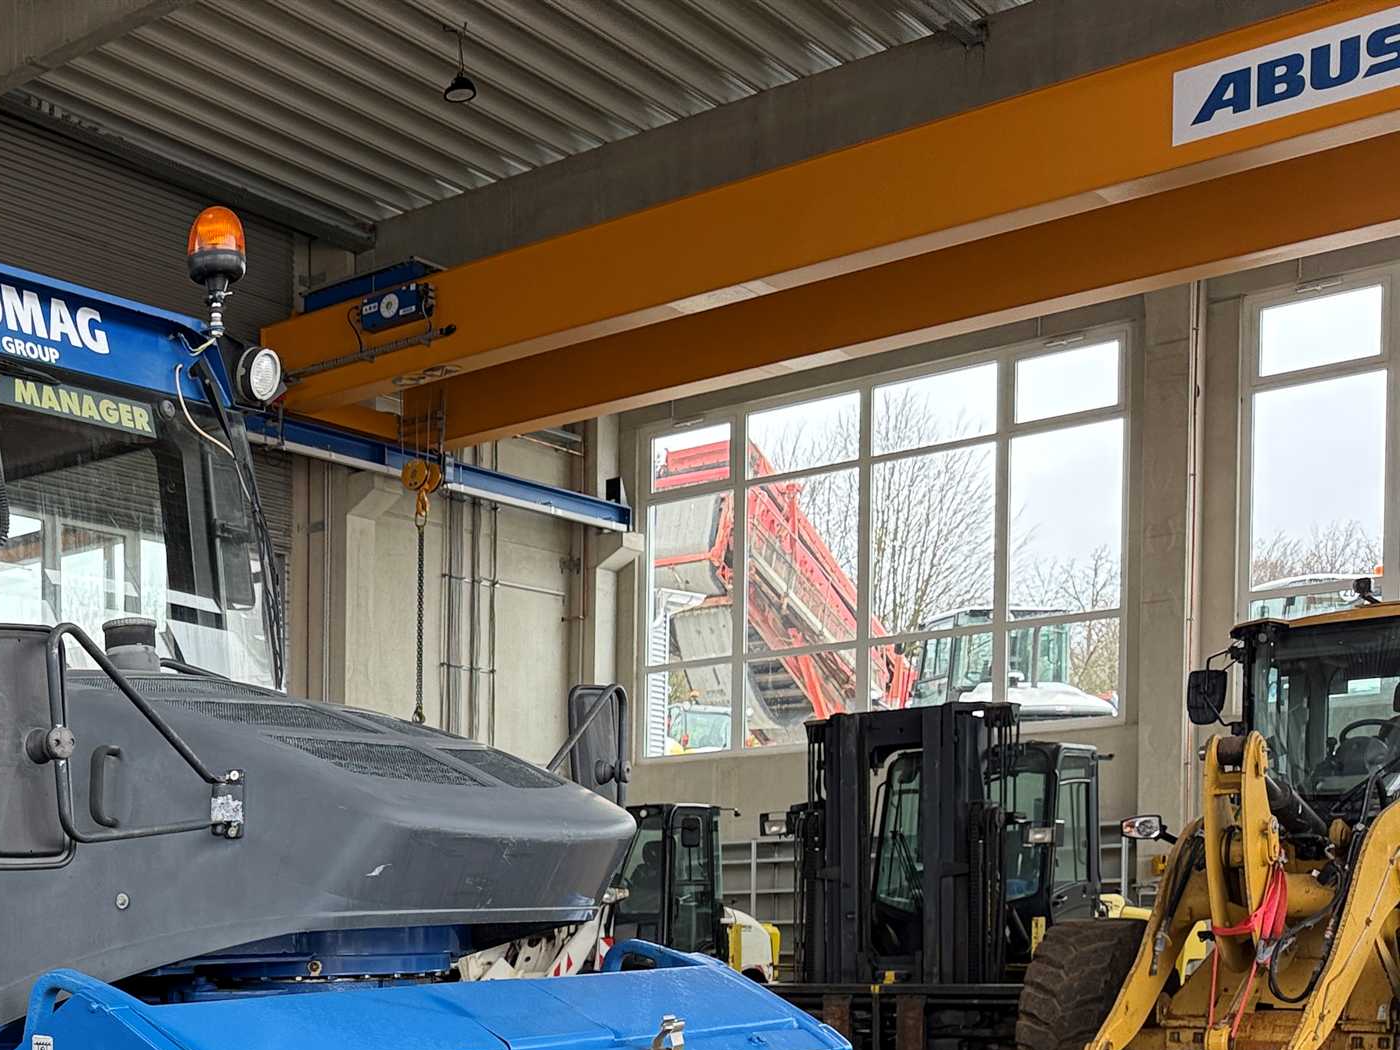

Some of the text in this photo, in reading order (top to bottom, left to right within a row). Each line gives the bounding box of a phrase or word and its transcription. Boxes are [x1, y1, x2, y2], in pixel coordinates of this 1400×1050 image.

[1190, 23, 1400, 127] ABUS
[2, 335, 60, 364] GROUP
[14, 378, 152, 432] MANAGER
